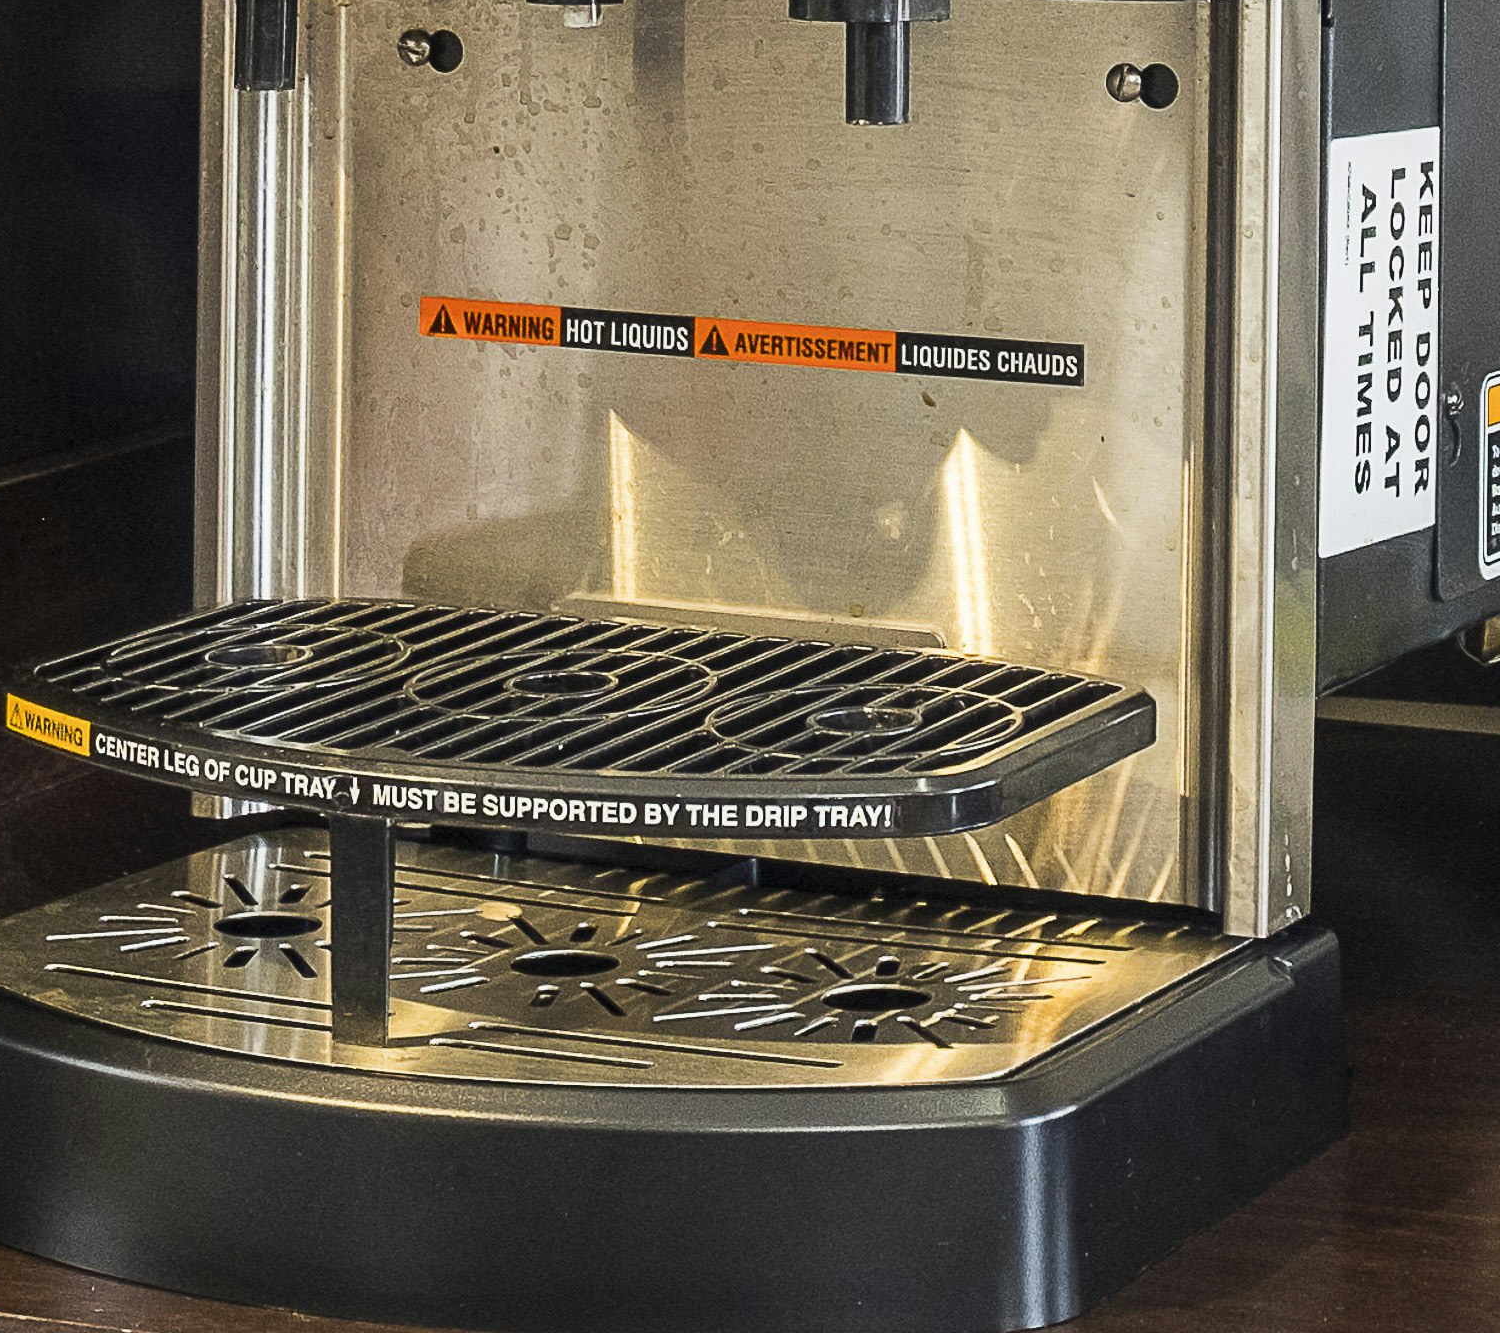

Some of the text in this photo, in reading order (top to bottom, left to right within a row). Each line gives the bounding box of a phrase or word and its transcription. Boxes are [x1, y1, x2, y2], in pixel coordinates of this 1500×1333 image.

[463, 311, 689, 352] WARNING HOT LIQUIDS
[734, 332, 1079, 379] AVERTISSEMENT LIQUIDES CHAUDS
[1354, 183, 1377, 495] ALL TIMES
[1384, 167, 1406, 498] LOCKED AT
[1414, 161, 1434, 497] KEEP DOOR
[24, 709, 892, 829] WARNING CENTER LEG OF CUP TRAY MUST BE SUPPORTED BY THE DRIP TRAY!
